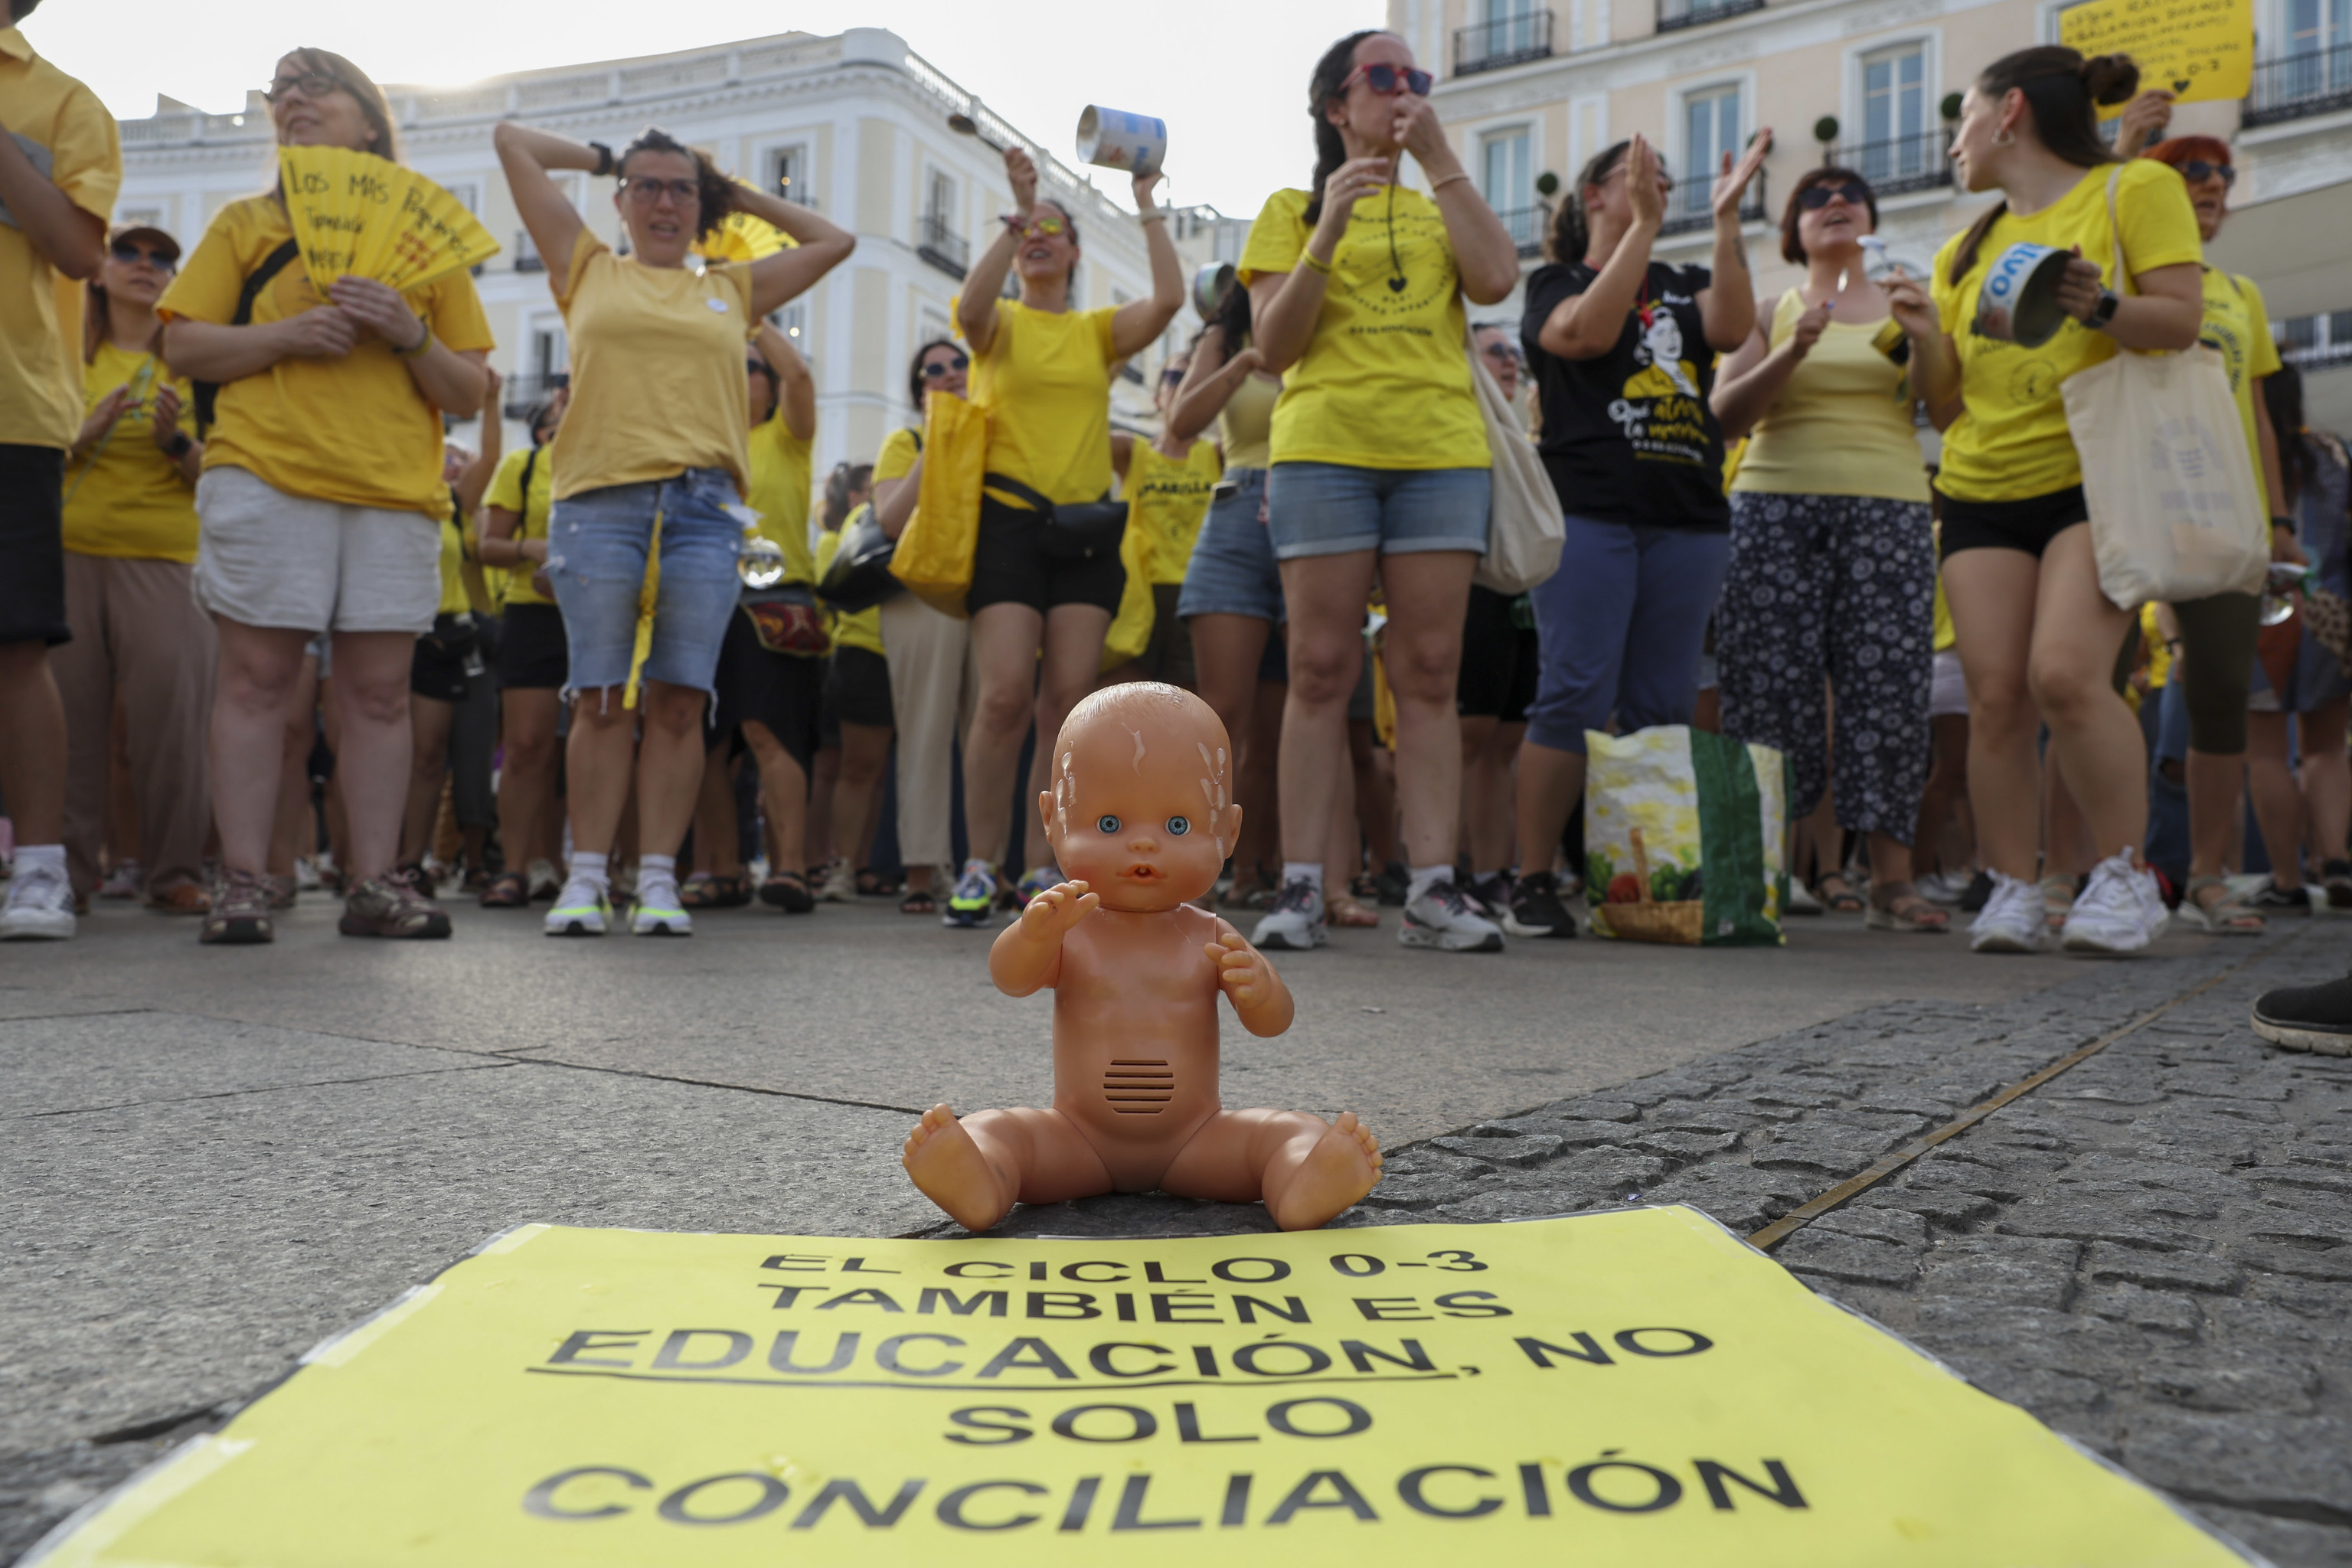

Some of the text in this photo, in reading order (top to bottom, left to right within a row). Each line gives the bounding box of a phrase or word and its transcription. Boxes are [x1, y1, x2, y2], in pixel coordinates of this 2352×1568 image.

[760, 1250, 1489, 1284] EL CICLO 0-3
[757, 1282, 1514, 1325] TAMBIÉN ES
[545, 1328, 1714, 1379] EDUCACIÓN, NO
[943, 1396, 1374, 1446] SOLO
[522, 1449, 1811, 1534] CONCILIACIÓN
